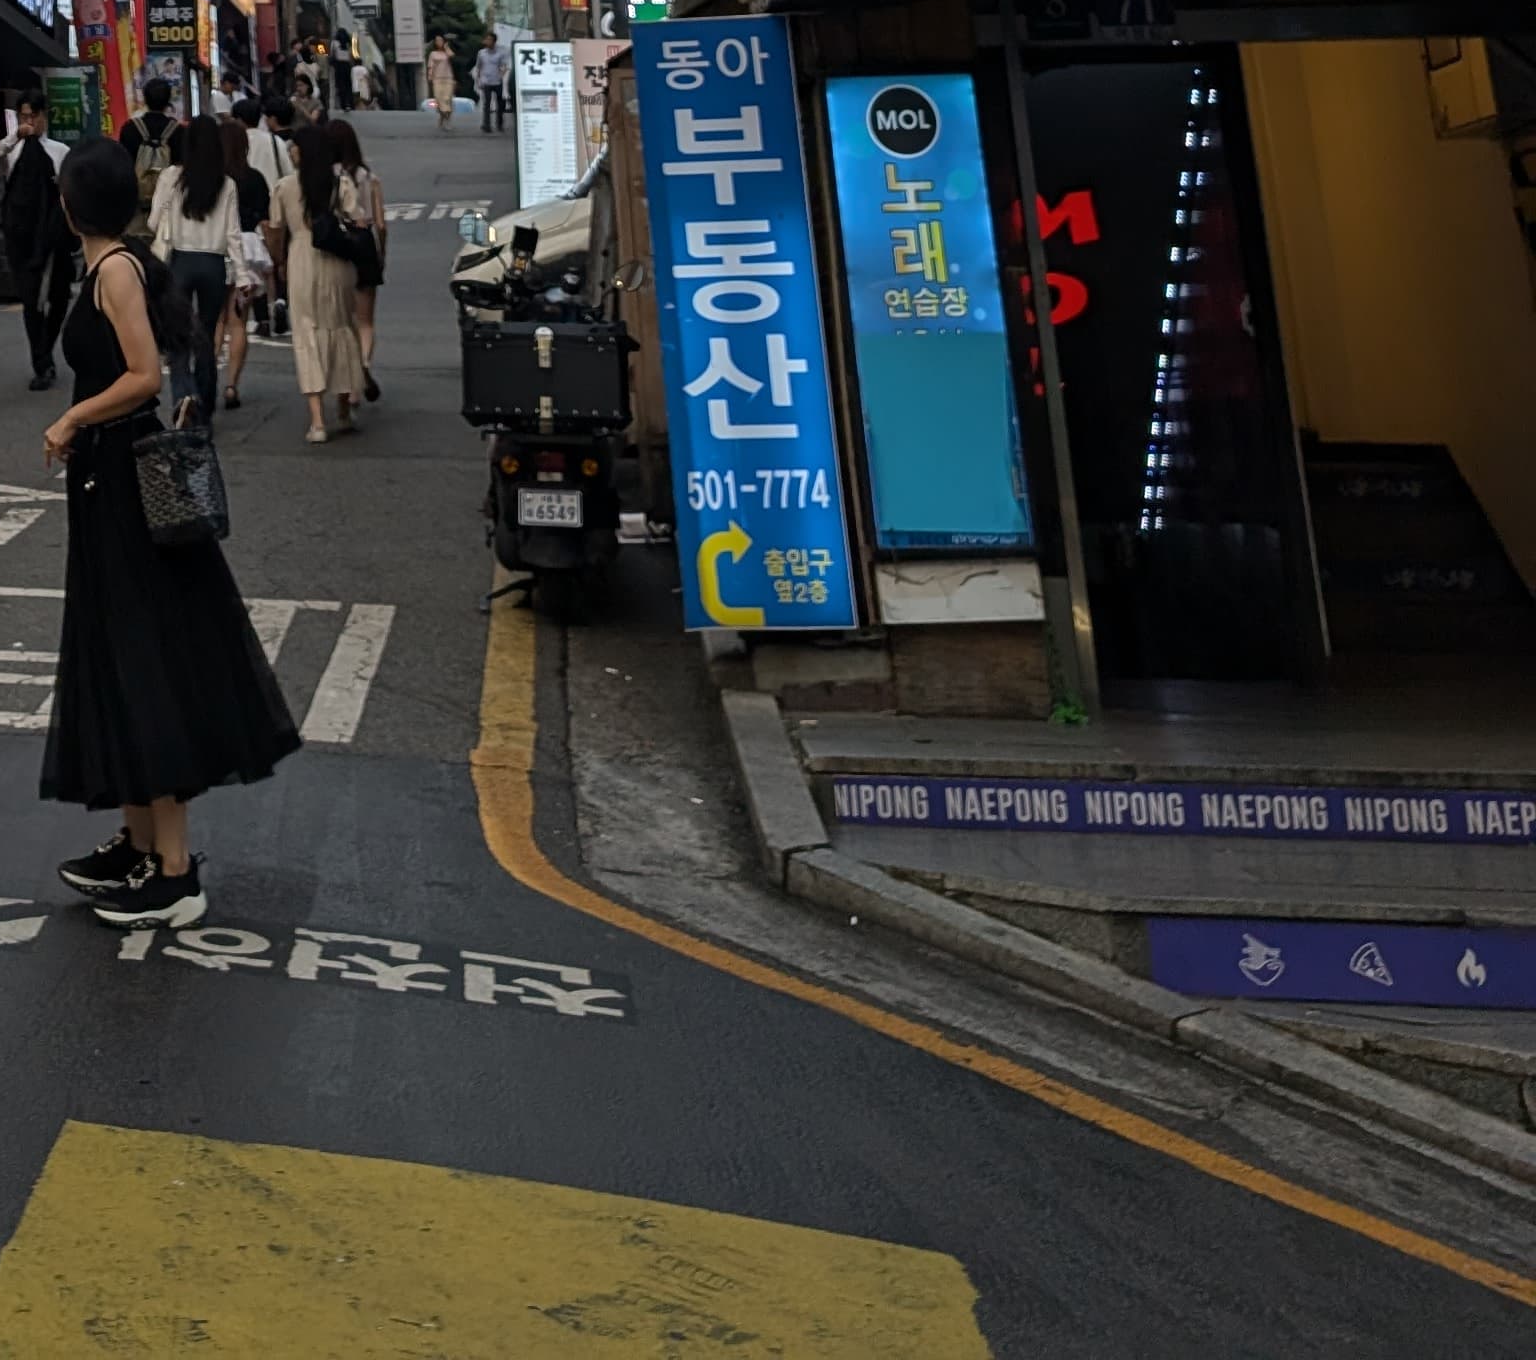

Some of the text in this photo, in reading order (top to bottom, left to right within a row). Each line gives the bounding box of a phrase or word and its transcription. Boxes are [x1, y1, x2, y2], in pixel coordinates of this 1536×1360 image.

[149, 25, 194, 42] 1900
[656, 33, 771, 91] 동아
[875, 107, 933, 134] MOL
[880, 162, 951, 286] 노래
[662, 104, 810, 443] 부동산
[882, 285, 970, 320] 연습장
[686, 467, 831, 512] 501-7774
[763, 547, 835, 577] 출입구
[834, 782, 930, 821] NIPONG
[945, 785, 1069, 825] NAEPONG
[1084, 790, 1186, 827] NIPONG
[1201, 792, 1329, 832] NAEPONG
[1345, 795, 1449, 835] NIPONG
